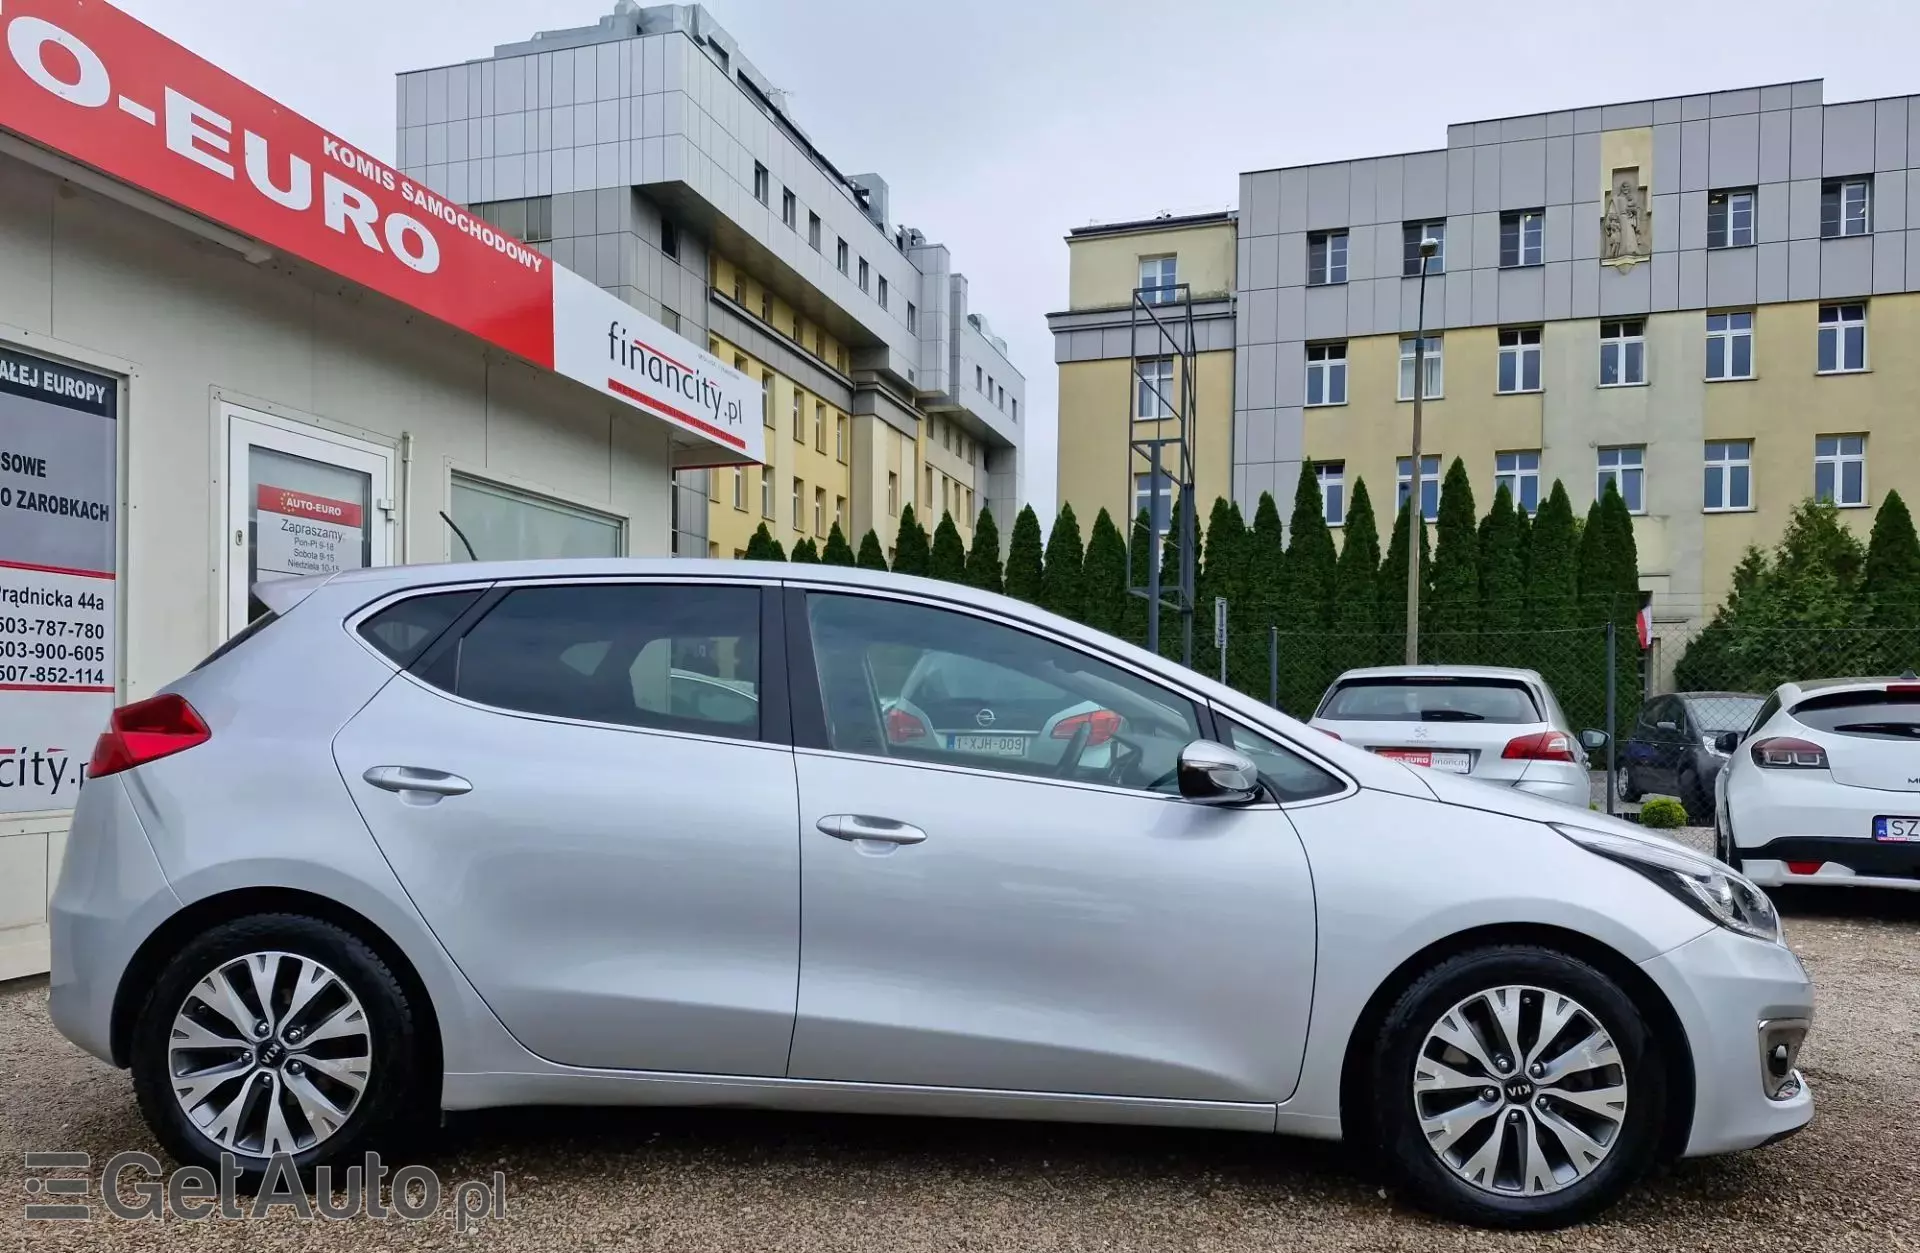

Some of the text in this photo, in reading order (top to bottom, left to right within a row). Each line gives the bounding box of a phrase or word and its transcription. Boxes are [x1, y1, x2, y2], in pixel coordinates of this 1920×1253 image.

[0, 0, 441, 275] O-EURO
[323, 135, 543, 273] KOMIS SAMOCHODOWY
[43, 370, 105, 404] EUROPY
[608, 321, 742, 425] financity.pl
[0, 451, 47, 478] SOWE
[16, 489, 109, 522] ZAROBKACH
[286, 498, 342, 516] AUTO-EURO
[281, 518, 343, 543] Zapraszamy
[0, 585, 104, 611] rądnicka 44a
[1891, 820, 1919, 837] SZ
